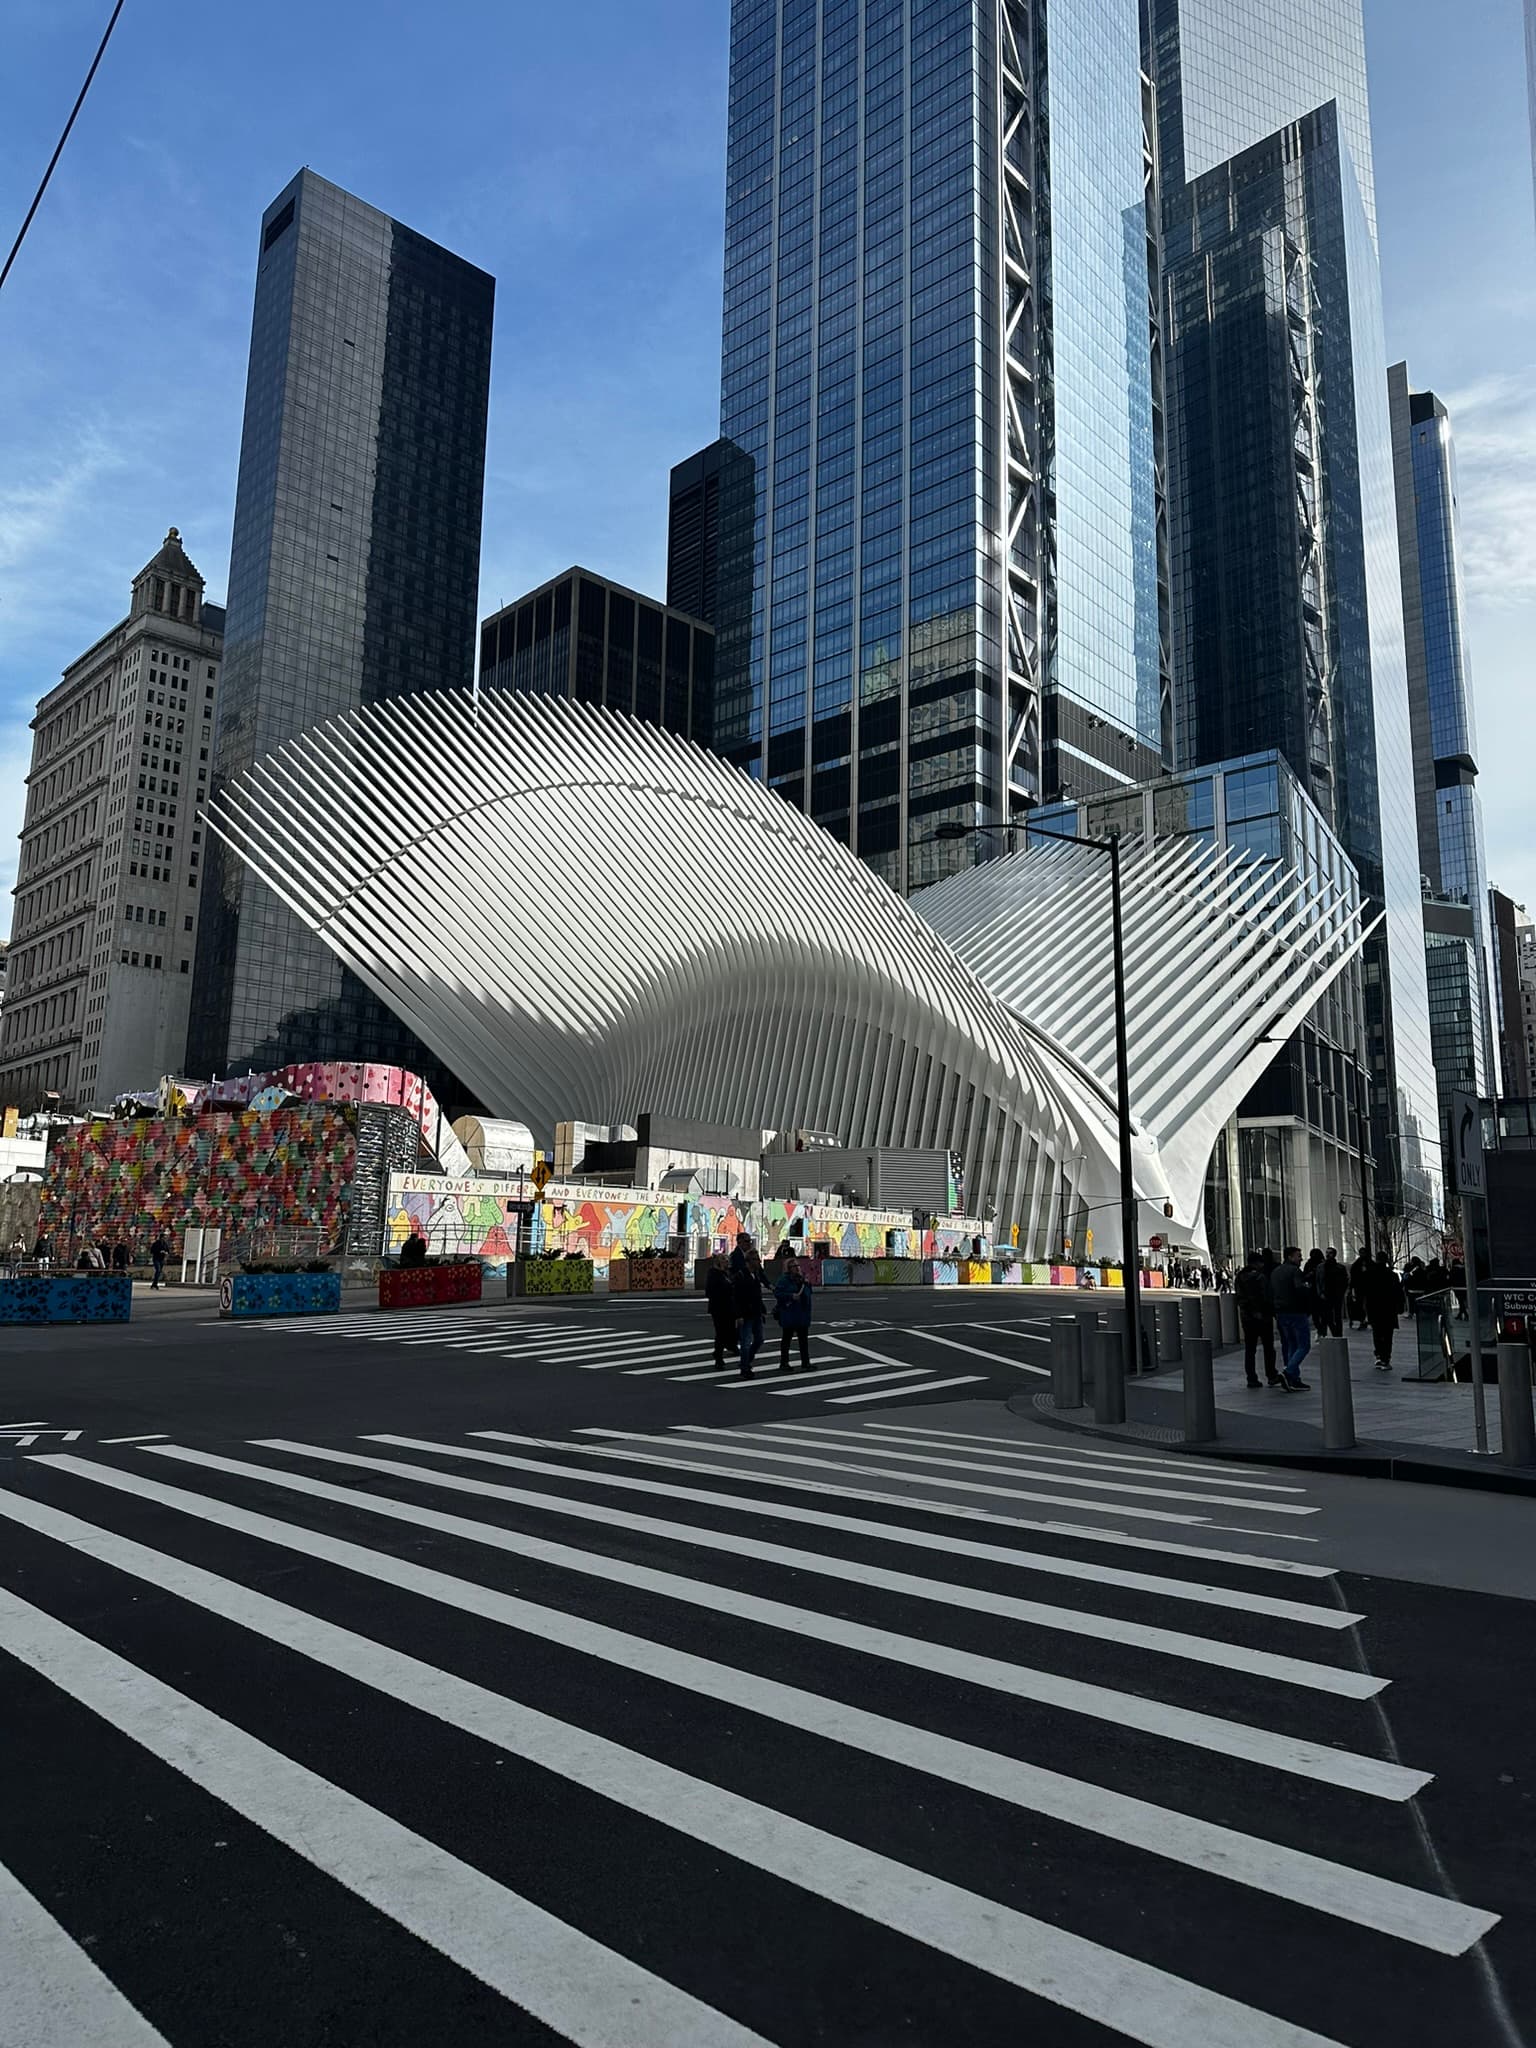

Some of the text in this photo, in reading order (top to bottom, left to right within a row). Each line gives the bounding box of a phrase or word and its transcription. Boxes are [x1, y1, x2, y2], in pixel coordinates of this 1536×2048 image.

[1461, 1162, 1481, 1187] ONLY
[403, 1176, 485, 1193] EVERYONE'S
[551, 1187, 570, 1198] AND
[576, 1188, 629, 1201] EVERYONE'S
[635, 1191, 649, 1202] THE
[655, 1193, 678, 1205] SAME
[1503, 1293, 1536, 1302] WTC C
[1503, 1301, 1536, 1312] Subway
